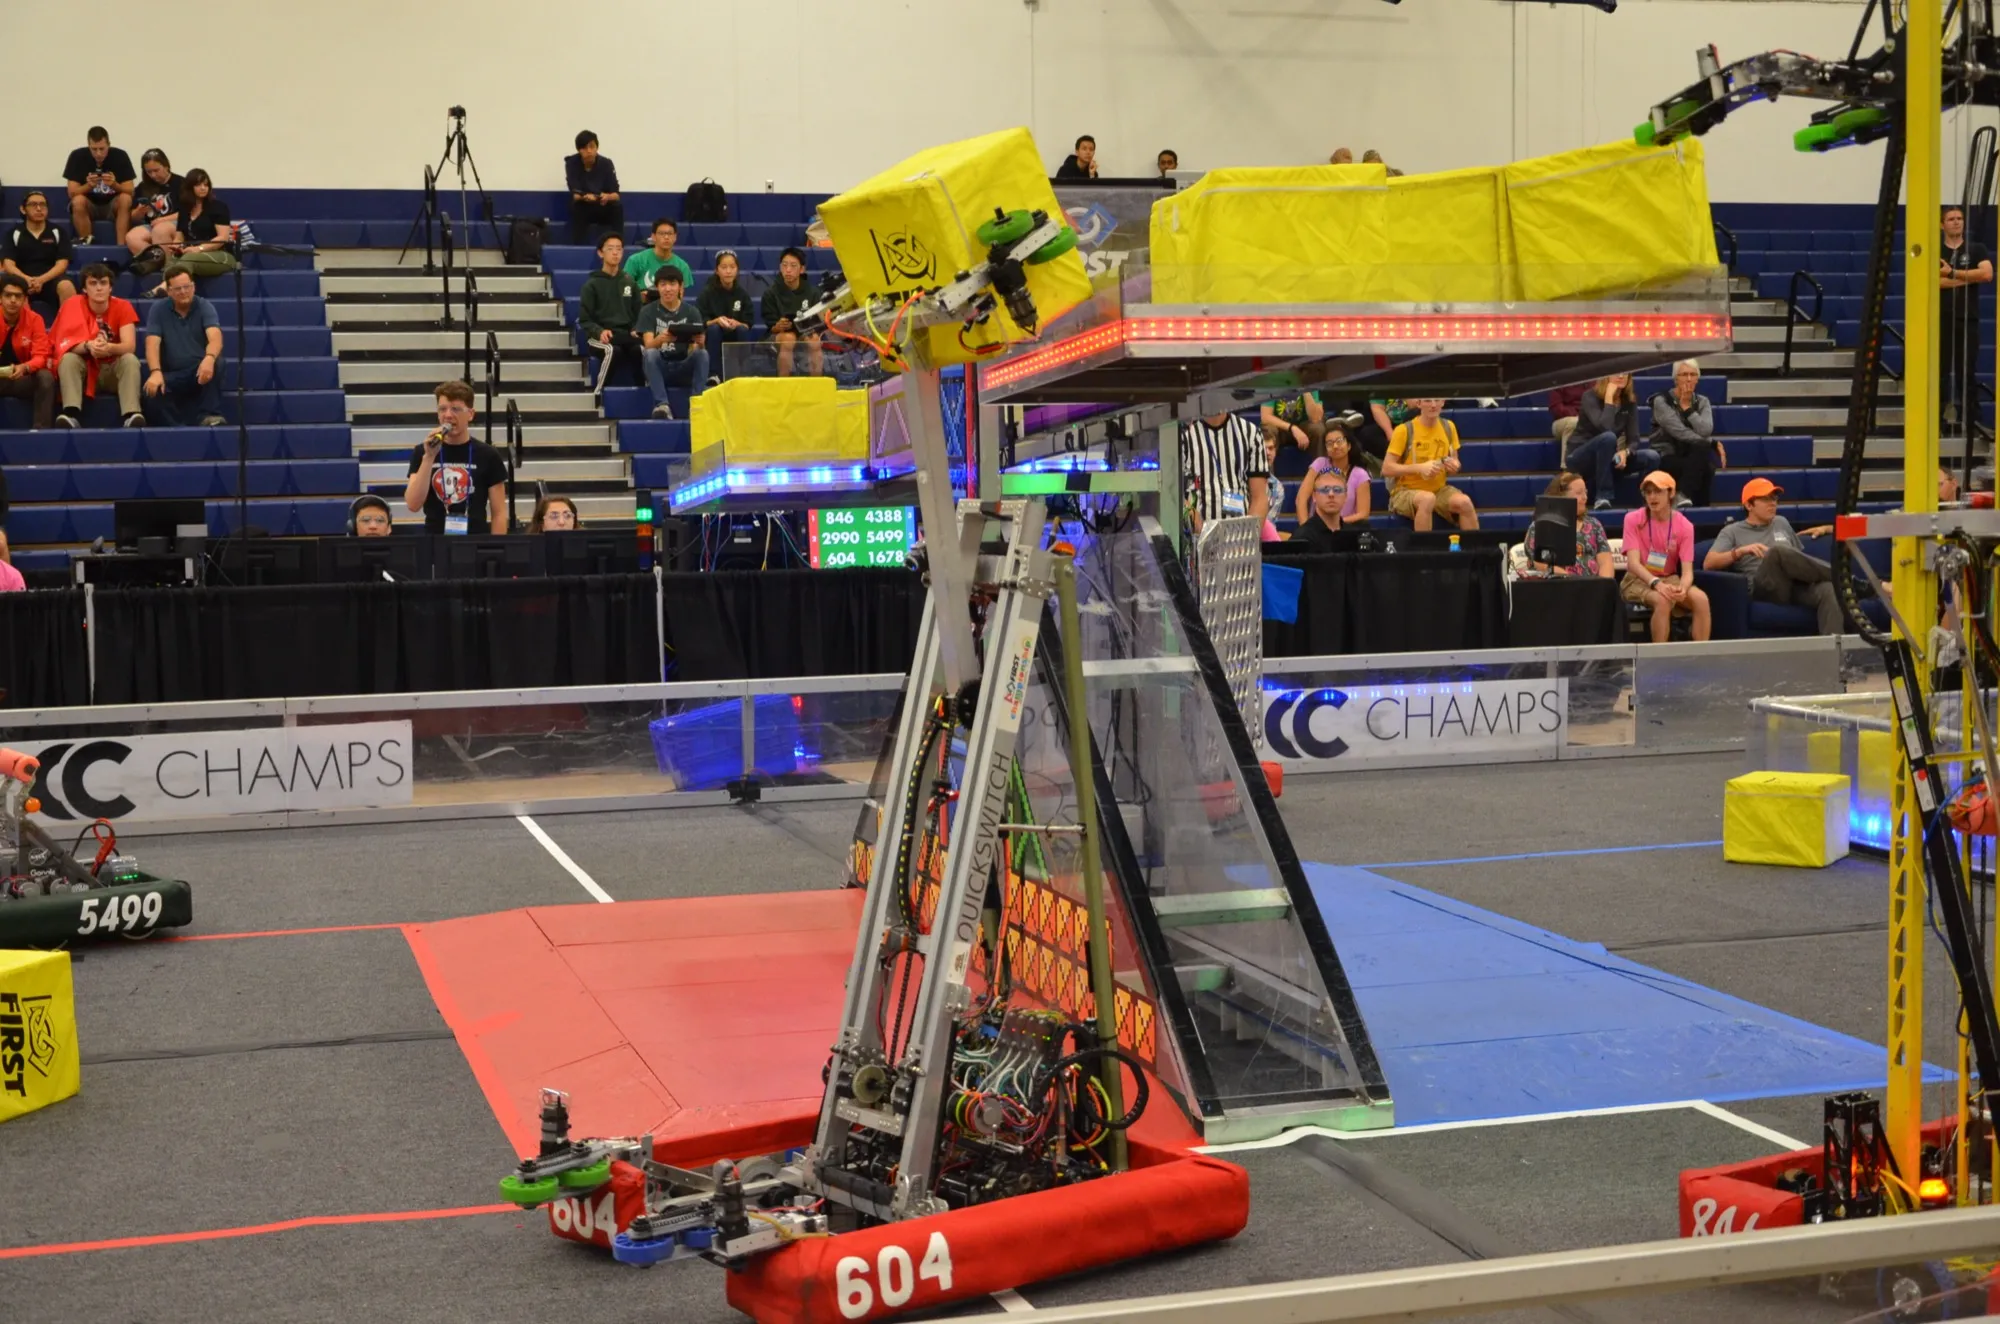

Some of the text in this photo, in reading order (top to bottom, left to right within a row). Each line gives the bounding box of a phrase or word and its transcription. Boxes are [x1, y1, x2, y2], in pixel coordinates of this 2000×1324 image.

[821, 531, 860, 545] 2990
[866, 529, 904, 544] 5499
[825, 511, 854, 525] 846
[864, 509, 903, 523] 4388
[827, 551, 857, 566] 604
[868, 550, 905, 564] 1678
[1365, 690, 1562, 741] CHAMPS
[155, 739, 405, 799] CHAMPS
[76, 891, 163, 936] 5499
[0, 992, 27, 1098] FIRST
[835, 1231, 953, 1320] 604
